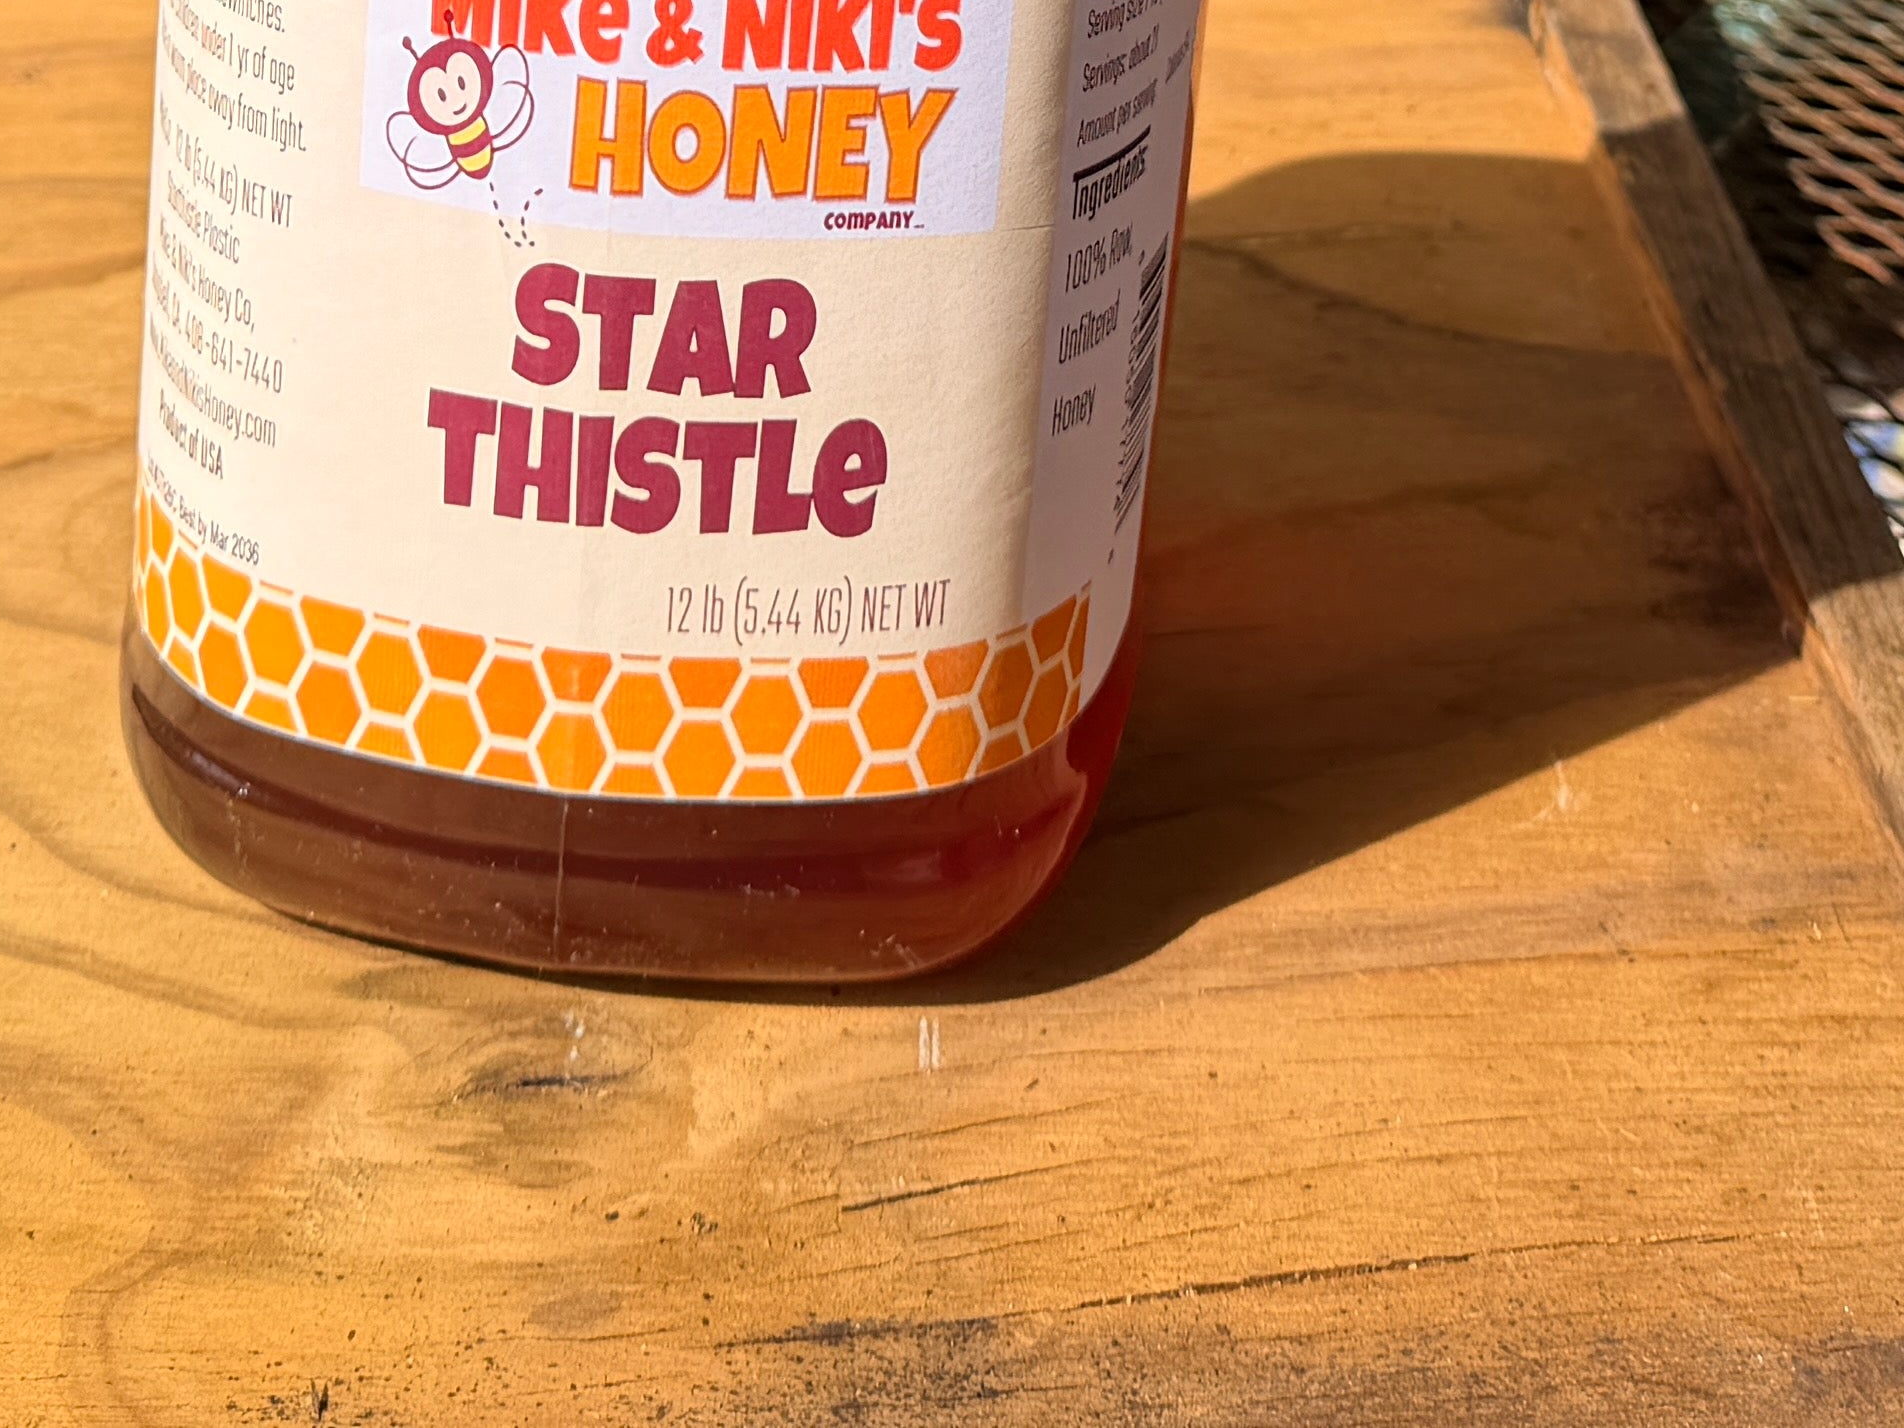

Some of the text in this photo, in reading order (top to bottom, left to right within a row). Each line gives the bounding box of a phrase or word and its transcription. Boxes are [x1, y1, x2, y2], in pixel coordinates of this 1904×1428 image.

[237, 42, 250, 79] yr
[253, 45, 267, 81] of
[270, 57, 295, 95] age
[237, 92, 268, 139] from
[567, 74, 959, 204] HONEY
[242, 178, 267, 219] NET
[270, 188, 294, 228] WT
[203, 210, 241, 264] Plastic
[1065, 236, 1107, 293] 100%
[197, 263, 233, 324] Honey
[510, 261, 818, 399] STAR
[1058, 287, 1121, 364] Unfiltered
[1051, 383, 1096, 436] Honey
[189, 428, 199, 462] of
[201, 434, 224, 480] USA
[198, 511, 208, 545] by
[210, 520, 230, 551] Mar
[231, 532, 260, 566] 2036
[667, 575, 951, 647] 12 lb (5.44 KG) NET WT
